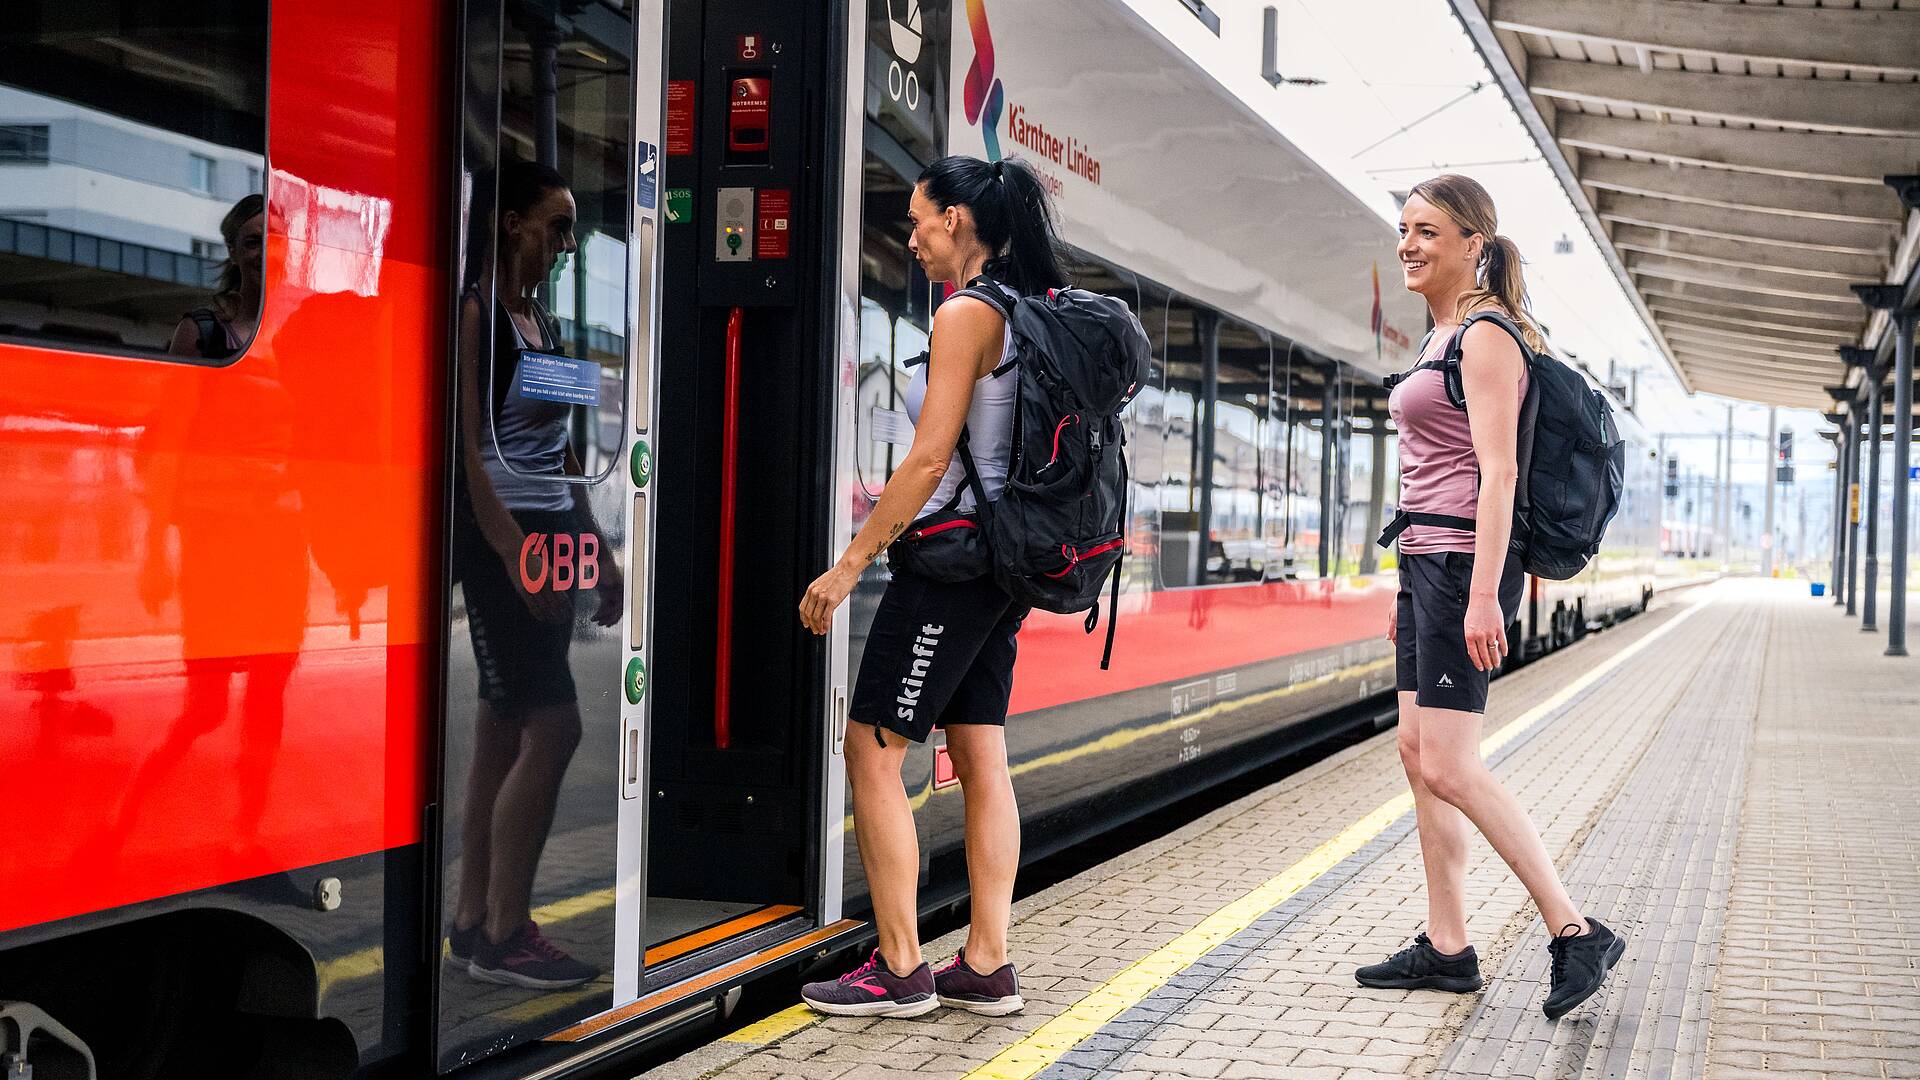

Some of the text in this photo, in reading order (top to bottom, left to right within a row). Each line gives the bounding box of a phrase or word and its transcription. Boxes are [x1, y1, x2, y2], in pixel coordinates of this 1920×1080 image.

[1009, 102, 1100, 186] Kärntner Linien
[519, 532, 600, 594] ÖBB
[896, 623, 945, 722] skinfit
